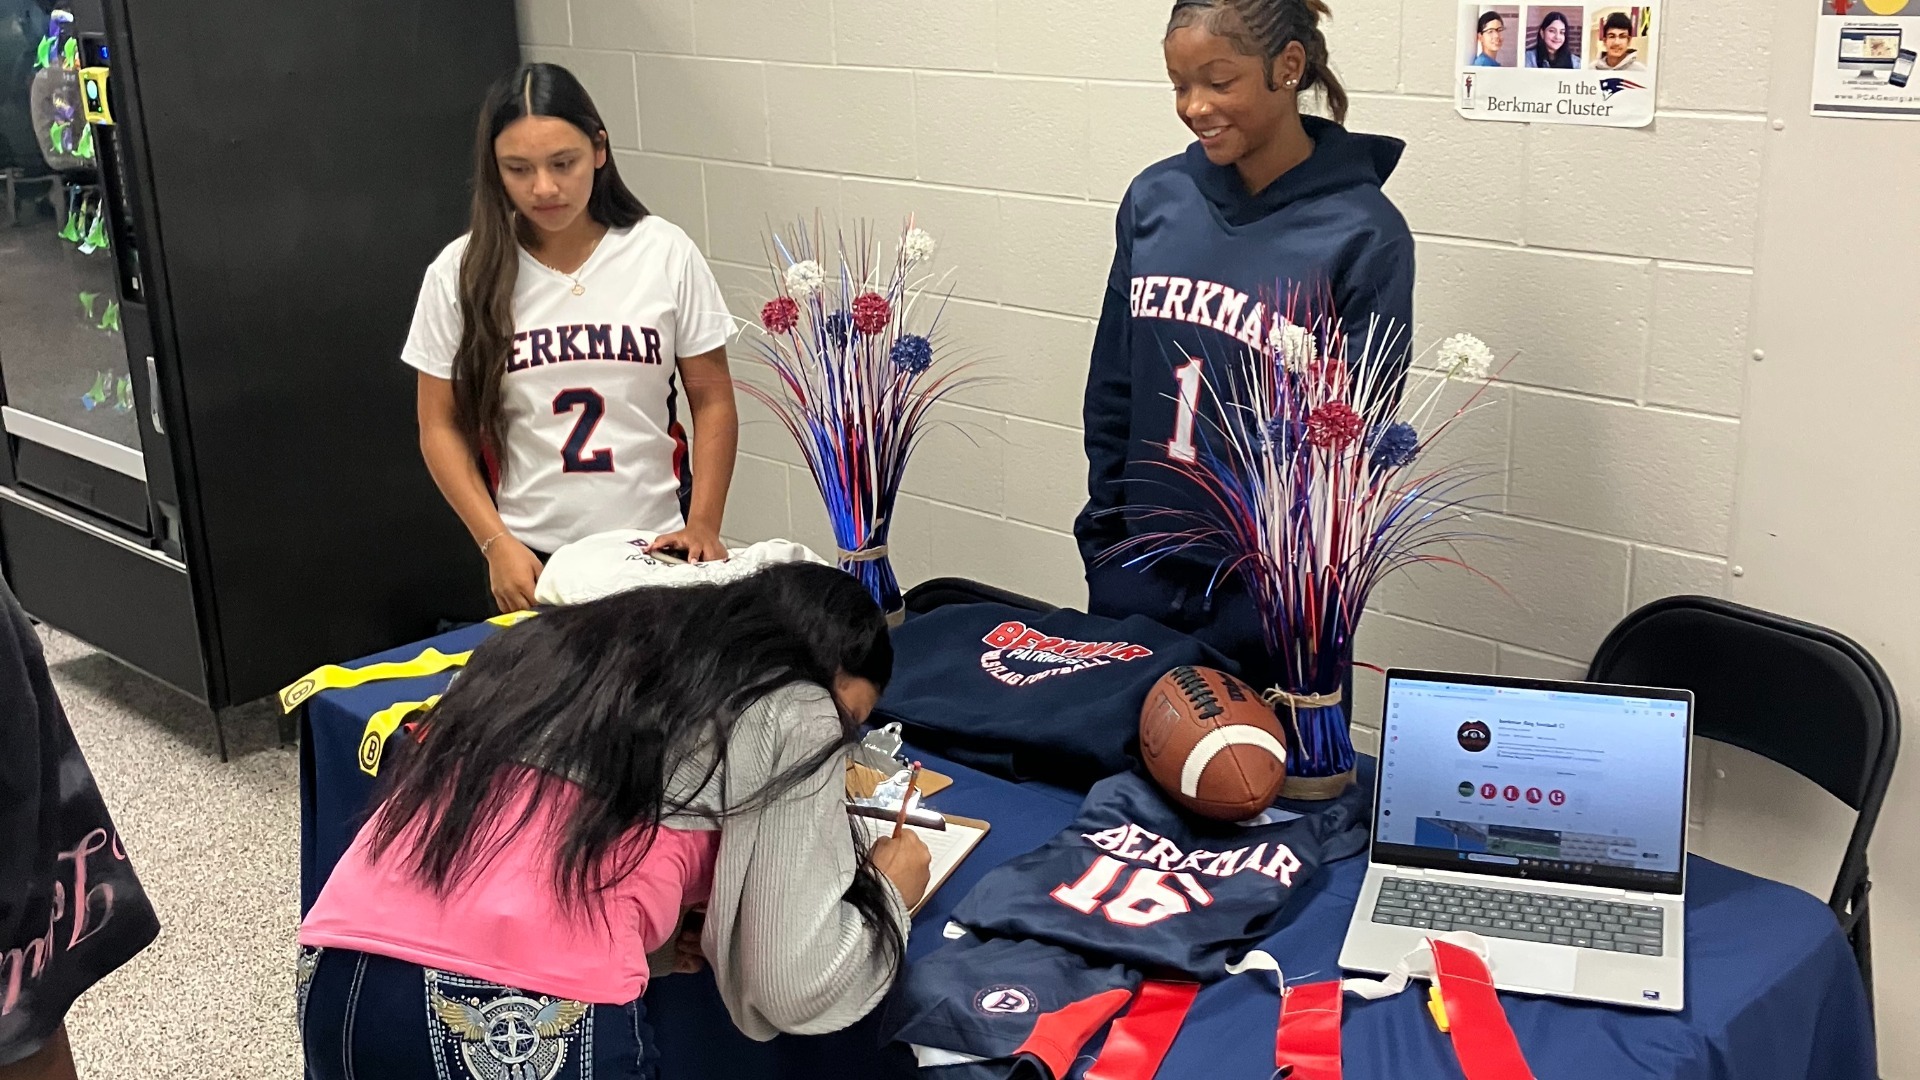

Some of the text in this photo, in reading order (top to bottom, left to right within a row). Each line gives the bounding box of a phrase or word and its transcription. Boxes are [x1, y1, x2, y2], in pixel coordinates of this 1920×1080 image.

[1487, 96, 1613, 117] Berkmar Cluster
[1558, 81, 1597, 95] In the
[506, 323, 662, 373] ERKMAR
[552, 387, 615, 474] 2
[1166, 356, 1204, 465] 1
[982, 620, 1153, 662] BERKMAR
[1019, 657, 1111, 686] FOOTBALL
[367, 739, 377, 761] B
[1080, 823, 1302, 887] BERKMAR
[1049, 854, 1214, 927] 16
